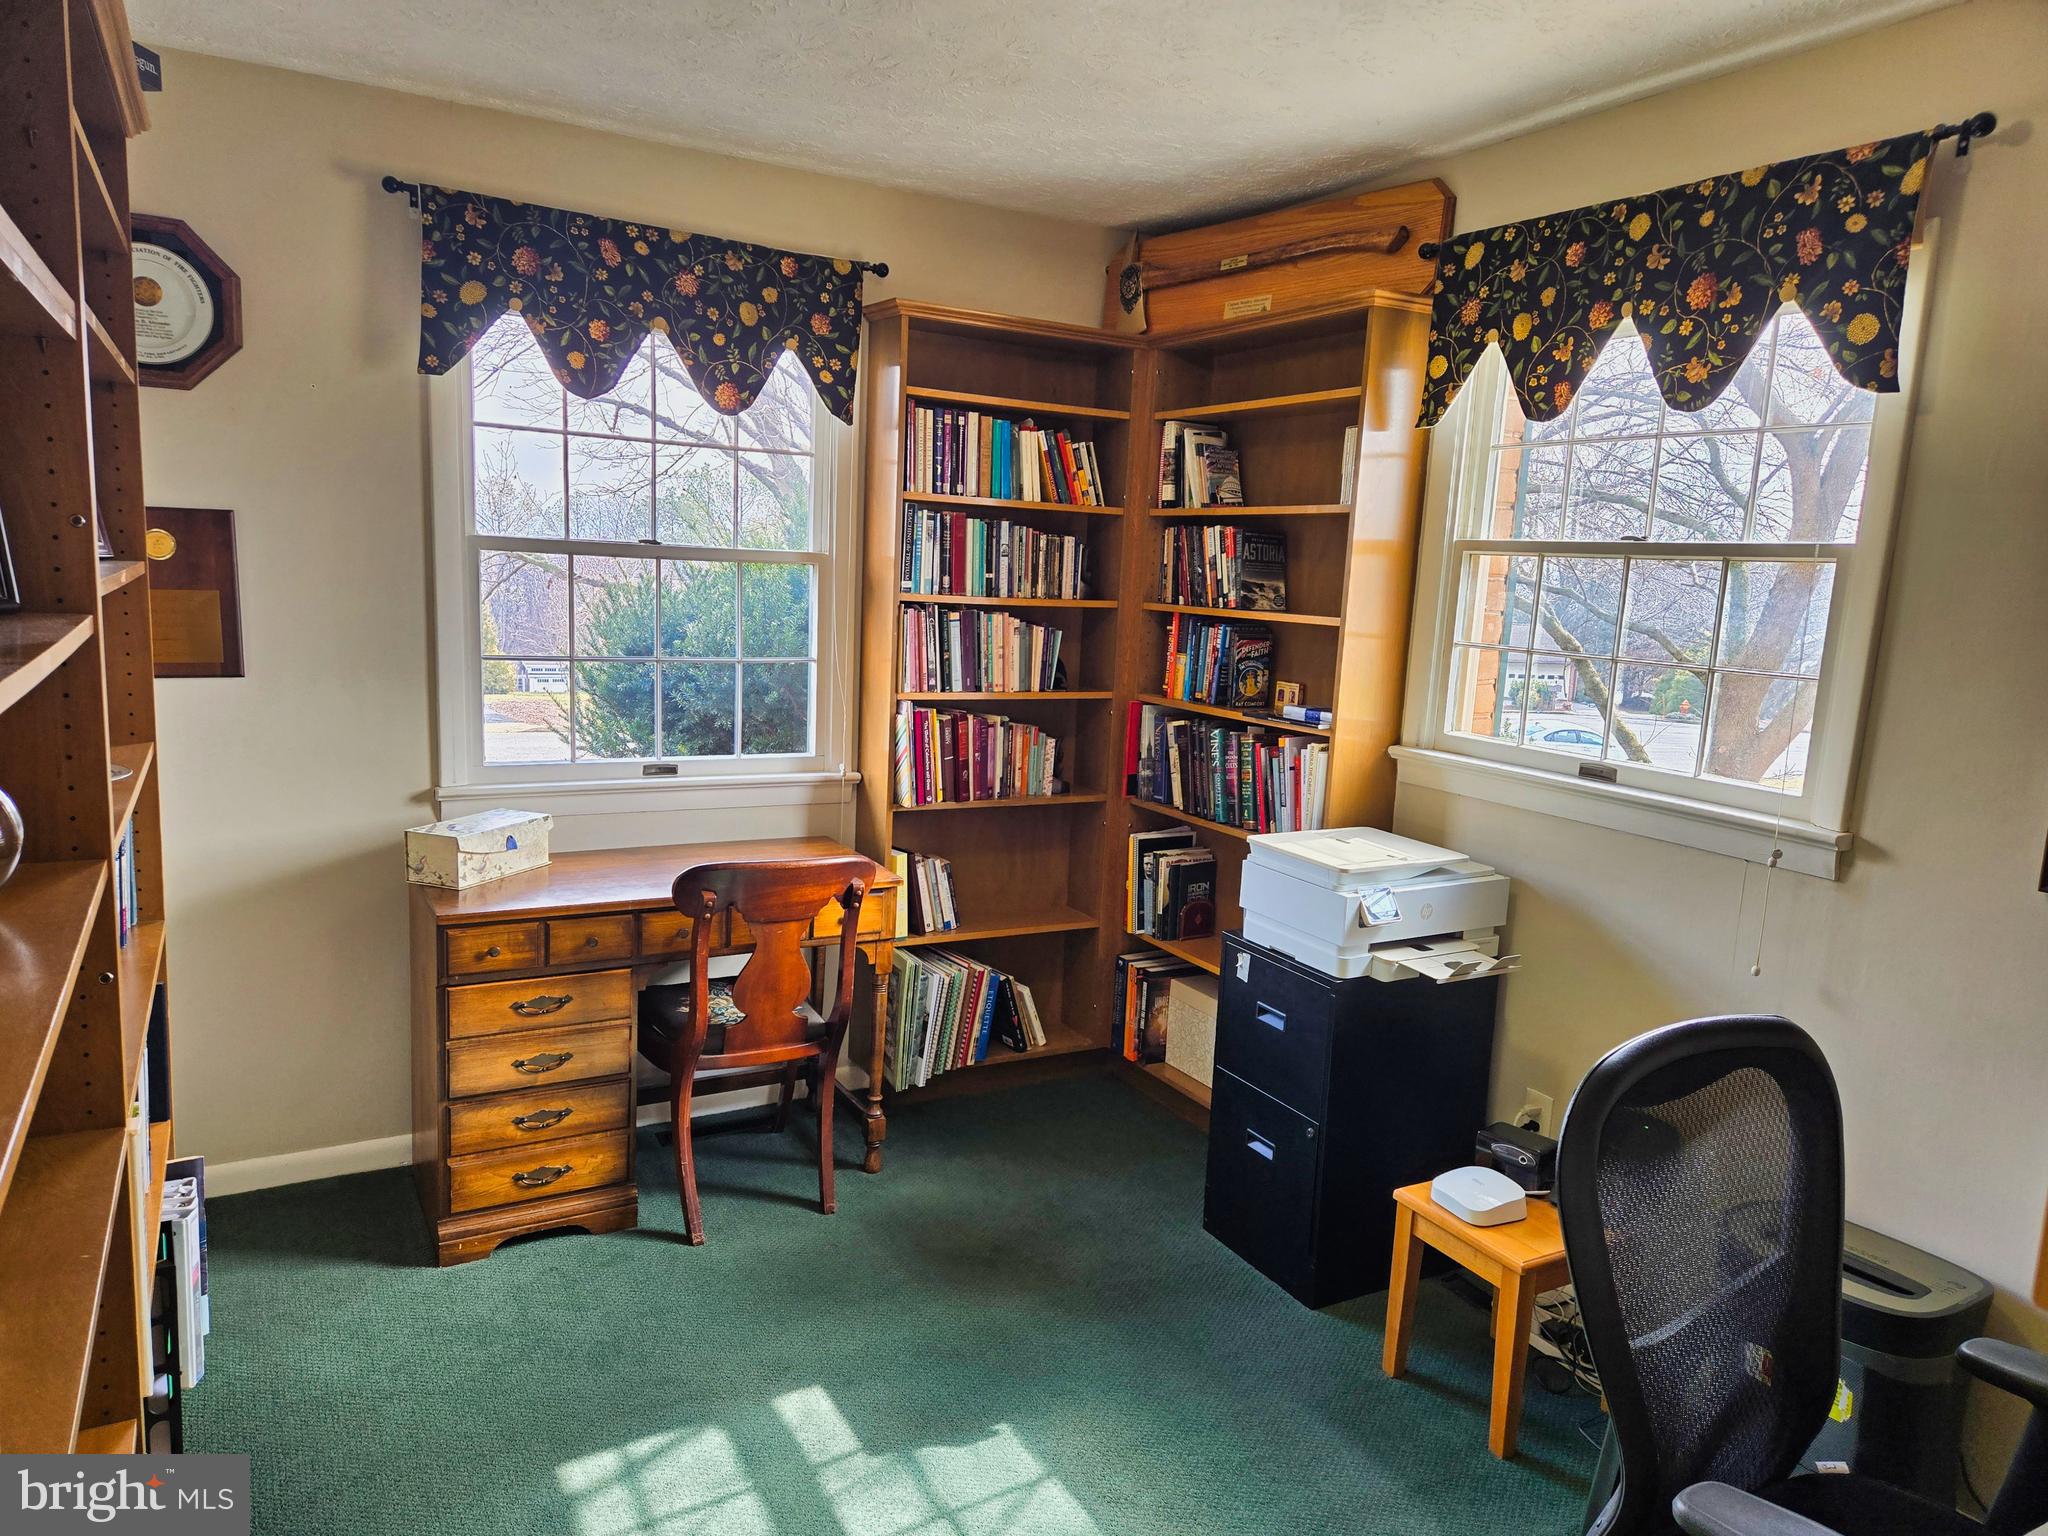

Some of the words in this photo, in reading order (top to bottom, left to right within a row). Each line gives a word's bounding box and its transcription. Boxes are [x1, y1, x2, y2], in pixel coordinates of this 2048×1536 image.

[173, 261, 189, 274] FIRE
[1243, 543, 1285, 562] ASTORIA
[1188, 881, 1210, 893] IRON
[983, 990, 994, 1034] ETIQUETTE
